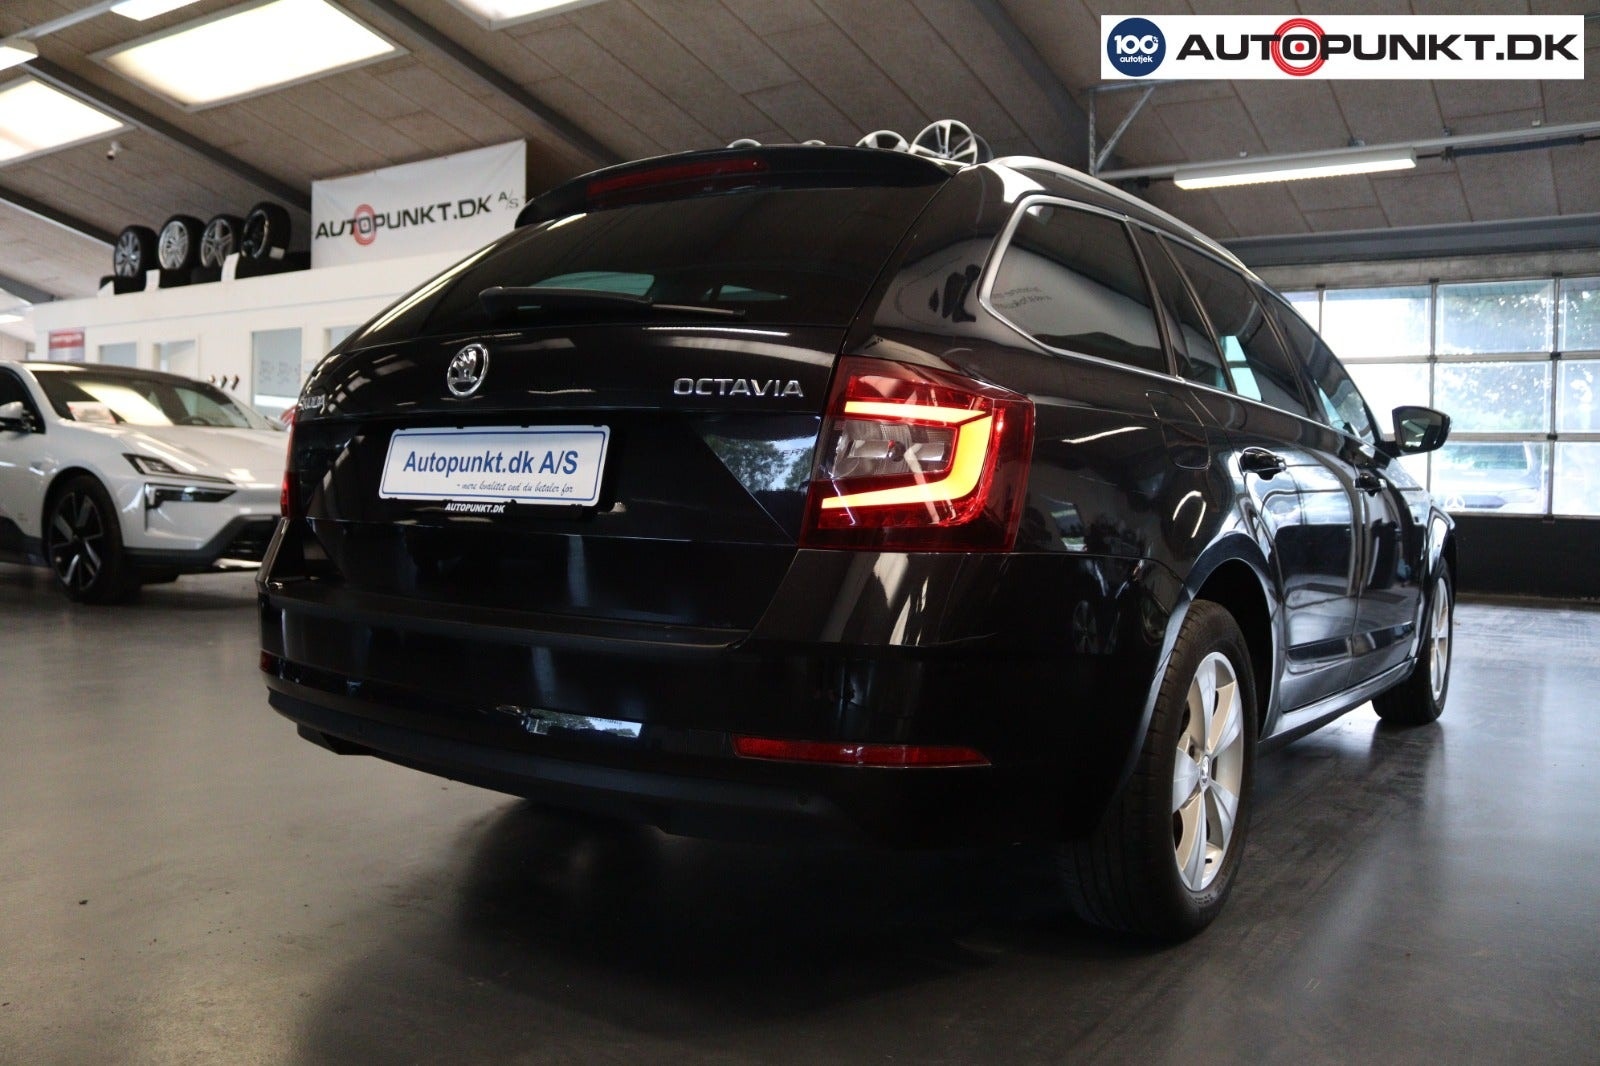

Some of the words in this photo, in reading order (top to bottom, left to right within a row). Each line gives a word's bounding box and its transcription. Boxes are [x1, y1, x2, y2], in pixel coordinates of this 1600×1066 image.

[315, 194, 493, 240] AUTOPUNKT.DK
[673, 377, 804, 397] OCTAVIA
[403, 451, 534, 478] Autopunkt.dk
[538, 450, 579, 475] A/S
[479, 480, 505, 491] kvalitet
[507, 482, 521, 491] end
[523, 482, 532, 492] du
[534, 482, 560, 493] betaler
[445, 502, 506, 514] AUTOPUNKT.DK
